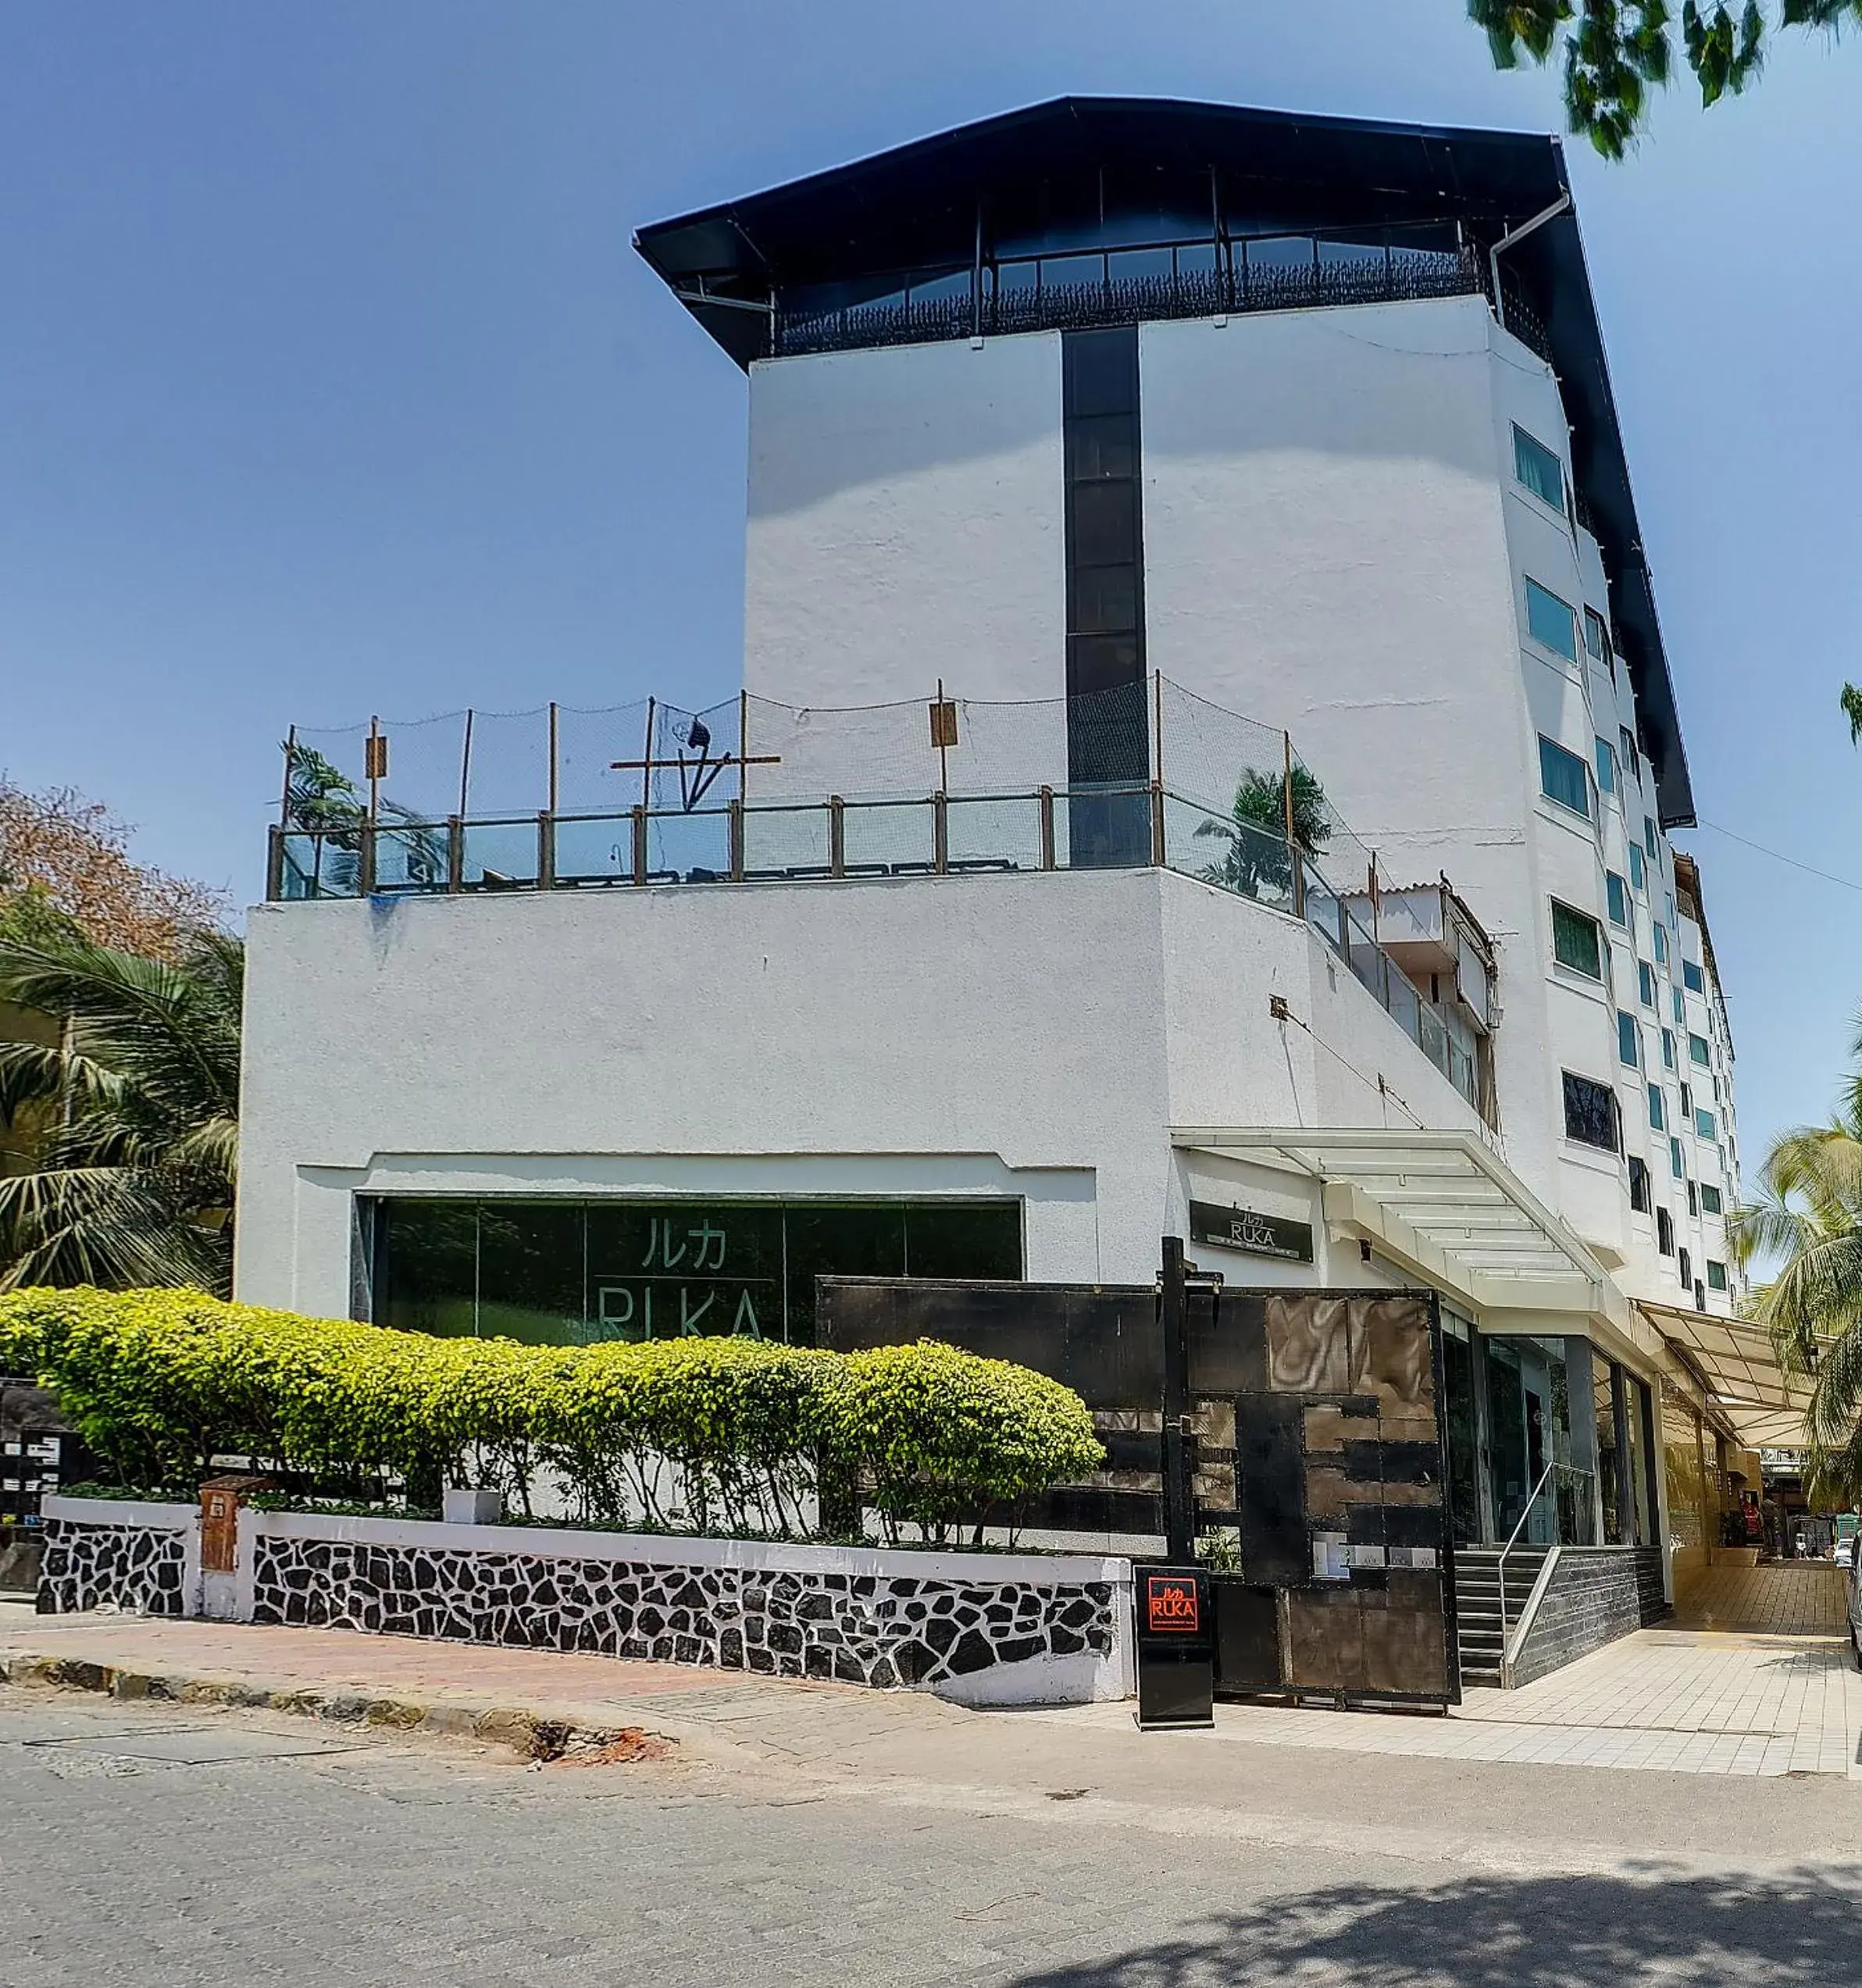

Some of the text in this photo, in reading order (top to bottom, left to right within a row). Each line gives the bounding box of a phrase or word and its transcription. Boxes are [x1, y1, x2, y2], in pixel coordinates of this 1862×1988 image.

[642, 1219, 726, 1269] ルカ
[1231, 1224, 1275, 1246] RUKA
[1152, 1600, 1195, 1616] RUKA
